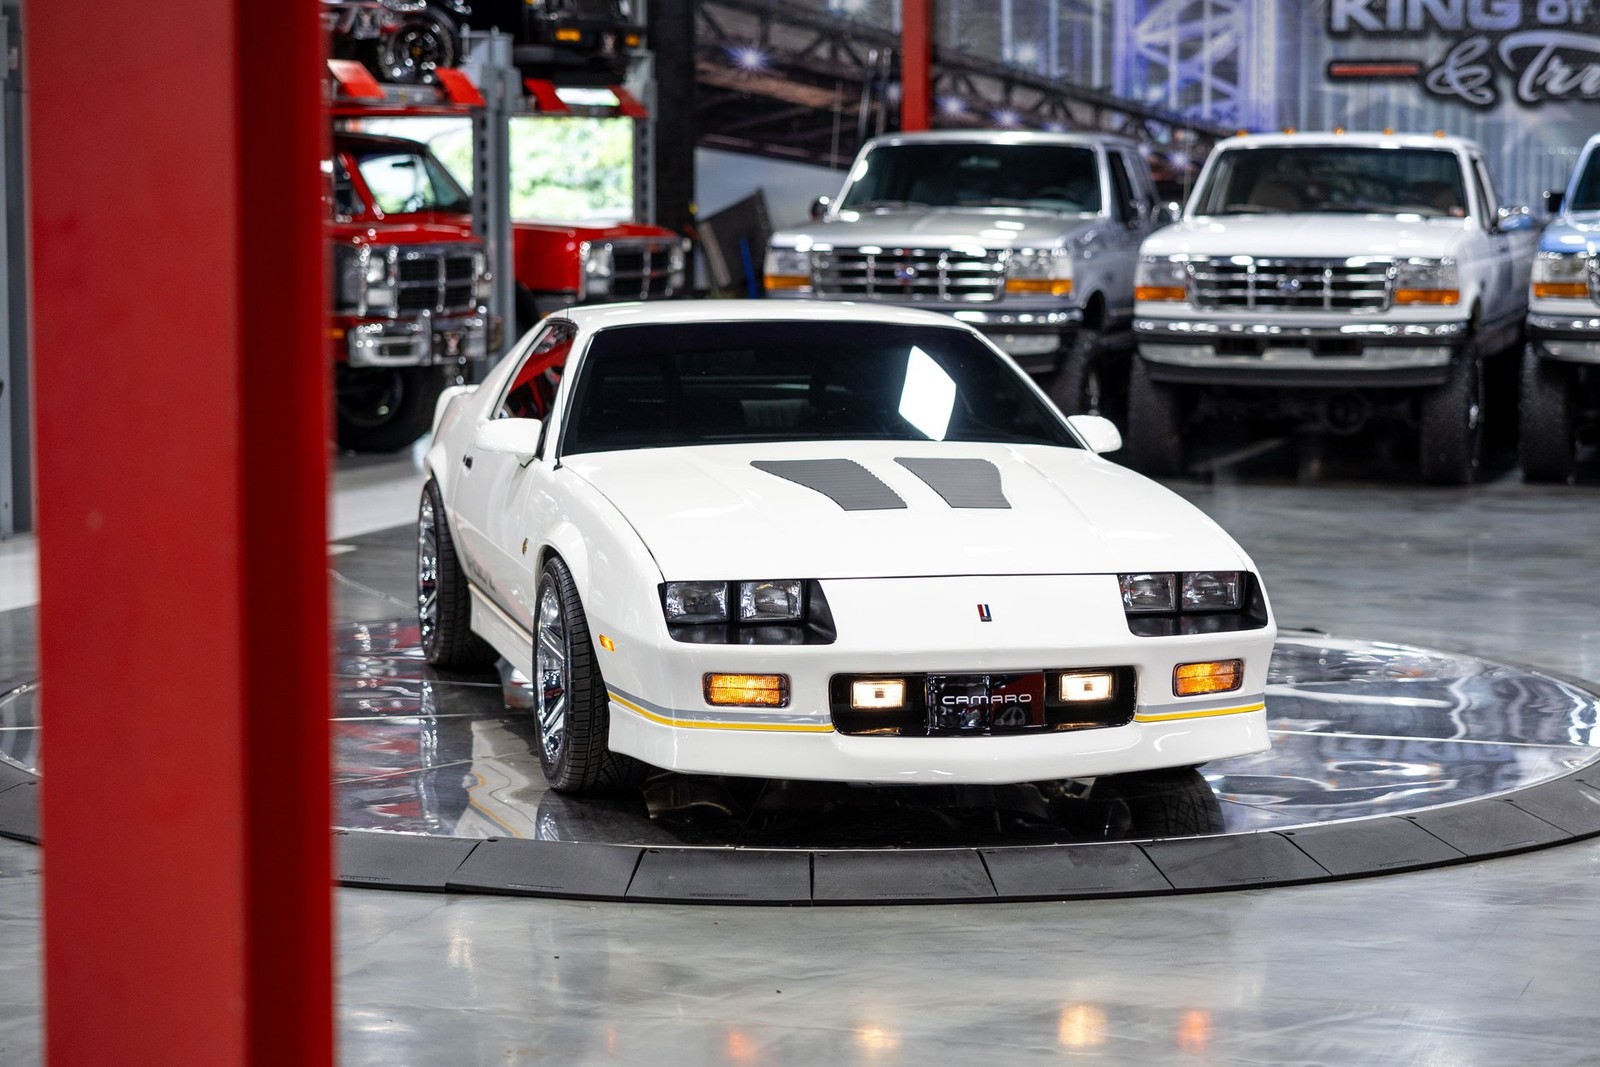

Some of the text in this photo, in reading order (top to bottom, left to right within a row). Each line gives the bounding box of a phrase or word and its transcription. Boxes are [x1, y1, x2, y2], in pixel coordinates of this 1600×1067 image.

[1331, 0, 1522, 31] KING
[1426, 36, 1495, 104] &
[942, 694, 1032, 704] CAMARO
